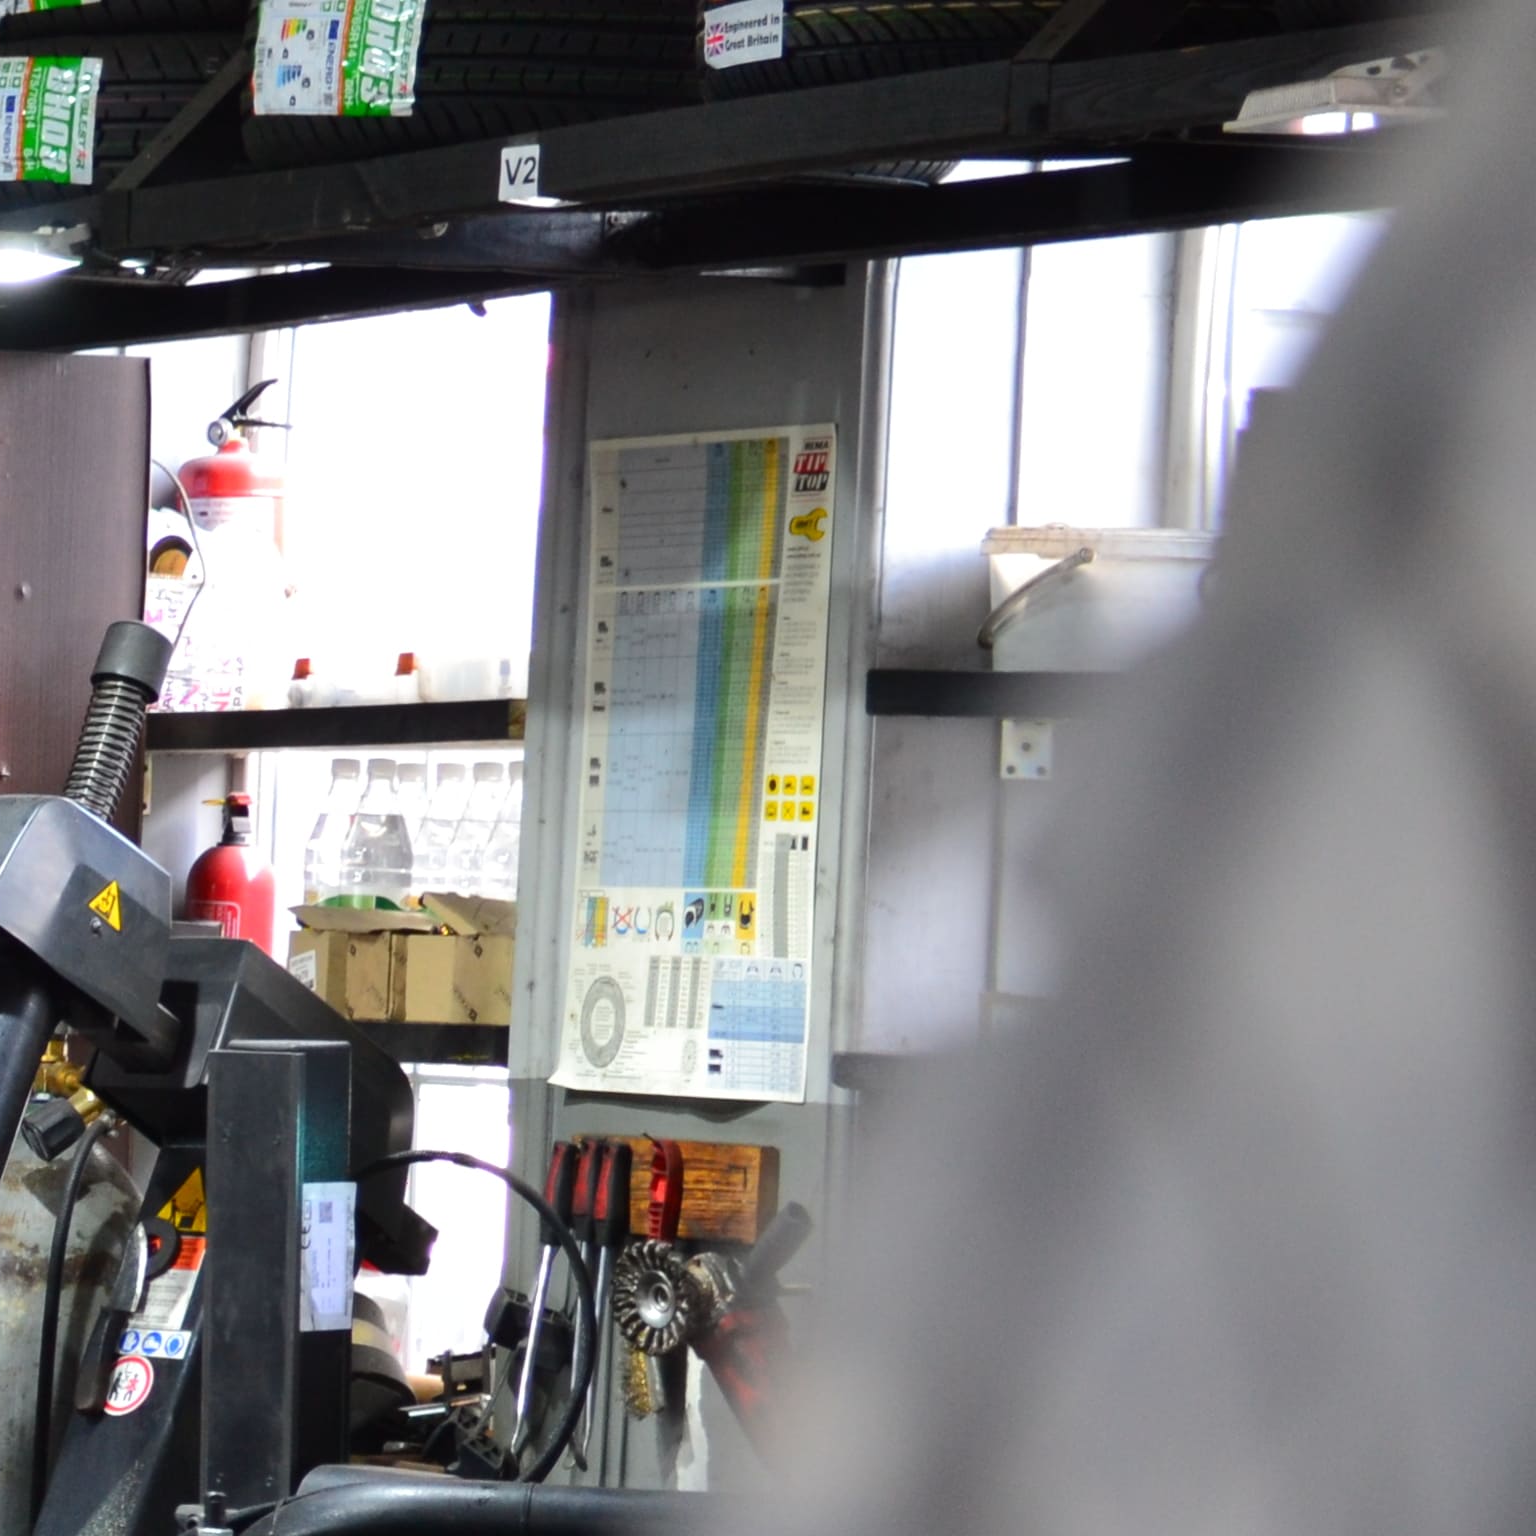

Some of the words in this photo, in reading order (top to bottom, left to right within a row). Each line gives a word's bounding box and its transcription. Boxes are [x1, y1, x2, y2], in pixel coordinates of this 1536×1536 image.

[724, 15, 768, 33] Engineered
[770, 14, 781, 25] in
[725, 38, 746, 51] Great
[748, 32, 780, 47] Britain
[505, 156, 537, 186] V2
[796, 454, 828, 473] TIP
[798, 474, 827, 491] TOP
